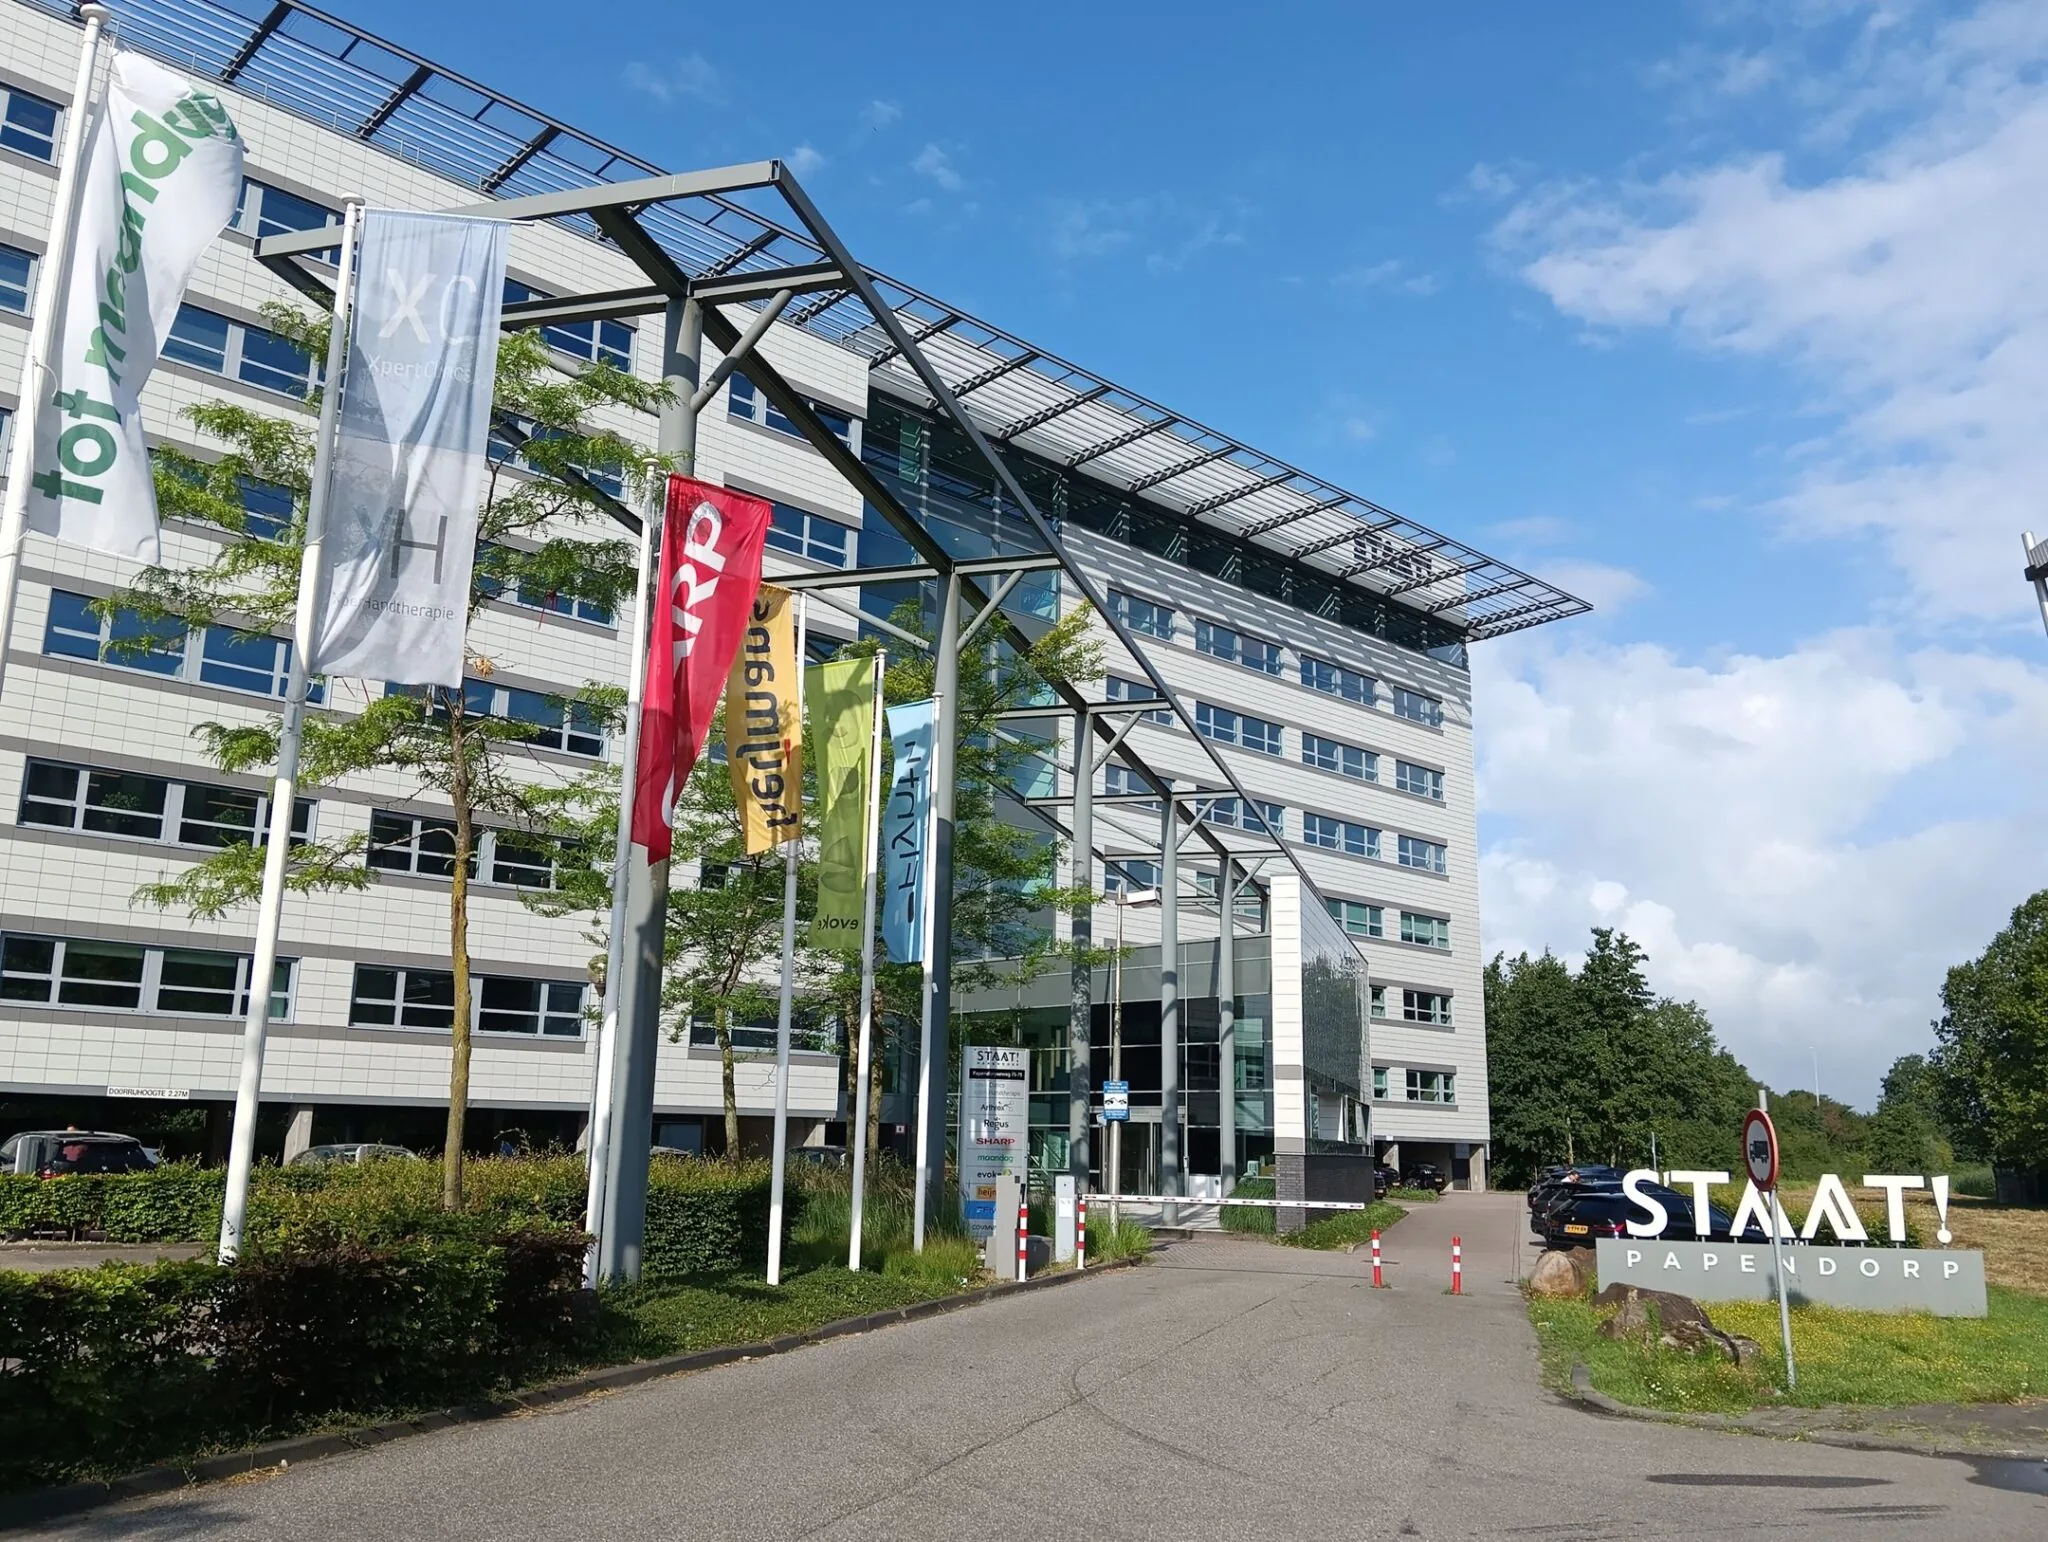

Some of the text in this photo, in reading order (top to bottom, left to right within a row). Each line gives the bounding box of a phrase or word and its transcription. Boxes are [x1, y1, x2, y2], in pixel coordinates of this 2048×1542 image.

[32, 388, 121, 505] tot
[977, 1050, 1020, 1062] STAAT!
[108, 1088, 166, 1096] DOORRIJHOOGTE
[984, 1120, 1009, 1130] Regus
[1622, 1168, 1952, 1244] STAAT!
[1626, 1250, 1960, 1280] PAPENDORP
